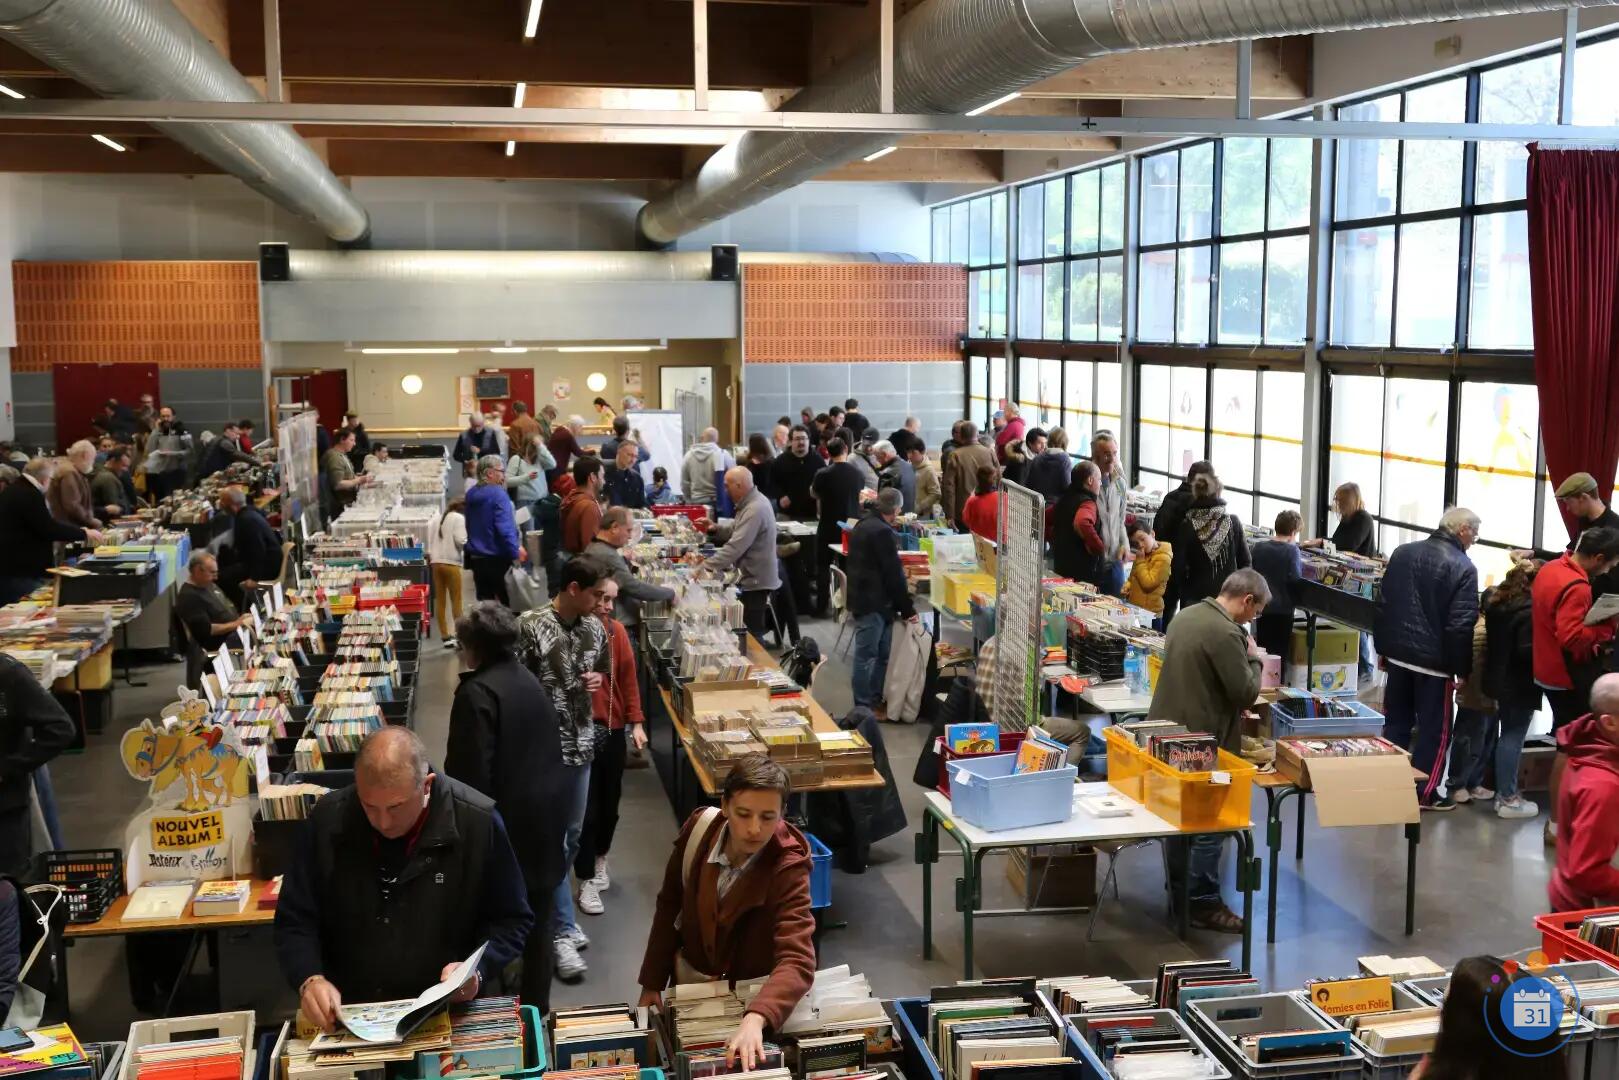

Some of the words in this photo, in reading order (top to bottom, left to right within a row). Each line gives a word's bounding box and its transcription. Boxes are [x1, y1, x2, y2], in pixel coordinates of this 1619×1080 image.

[156, 815, 220, 833] NOUVEL
[157, 831, 211, 847] ALBUM
[216, 827, 222, 840] !
[148, 853, 183, 868] Astérix
[1355, 1003, 1367, 1011] en
[1368, 999, 1390, 1010] Folie
